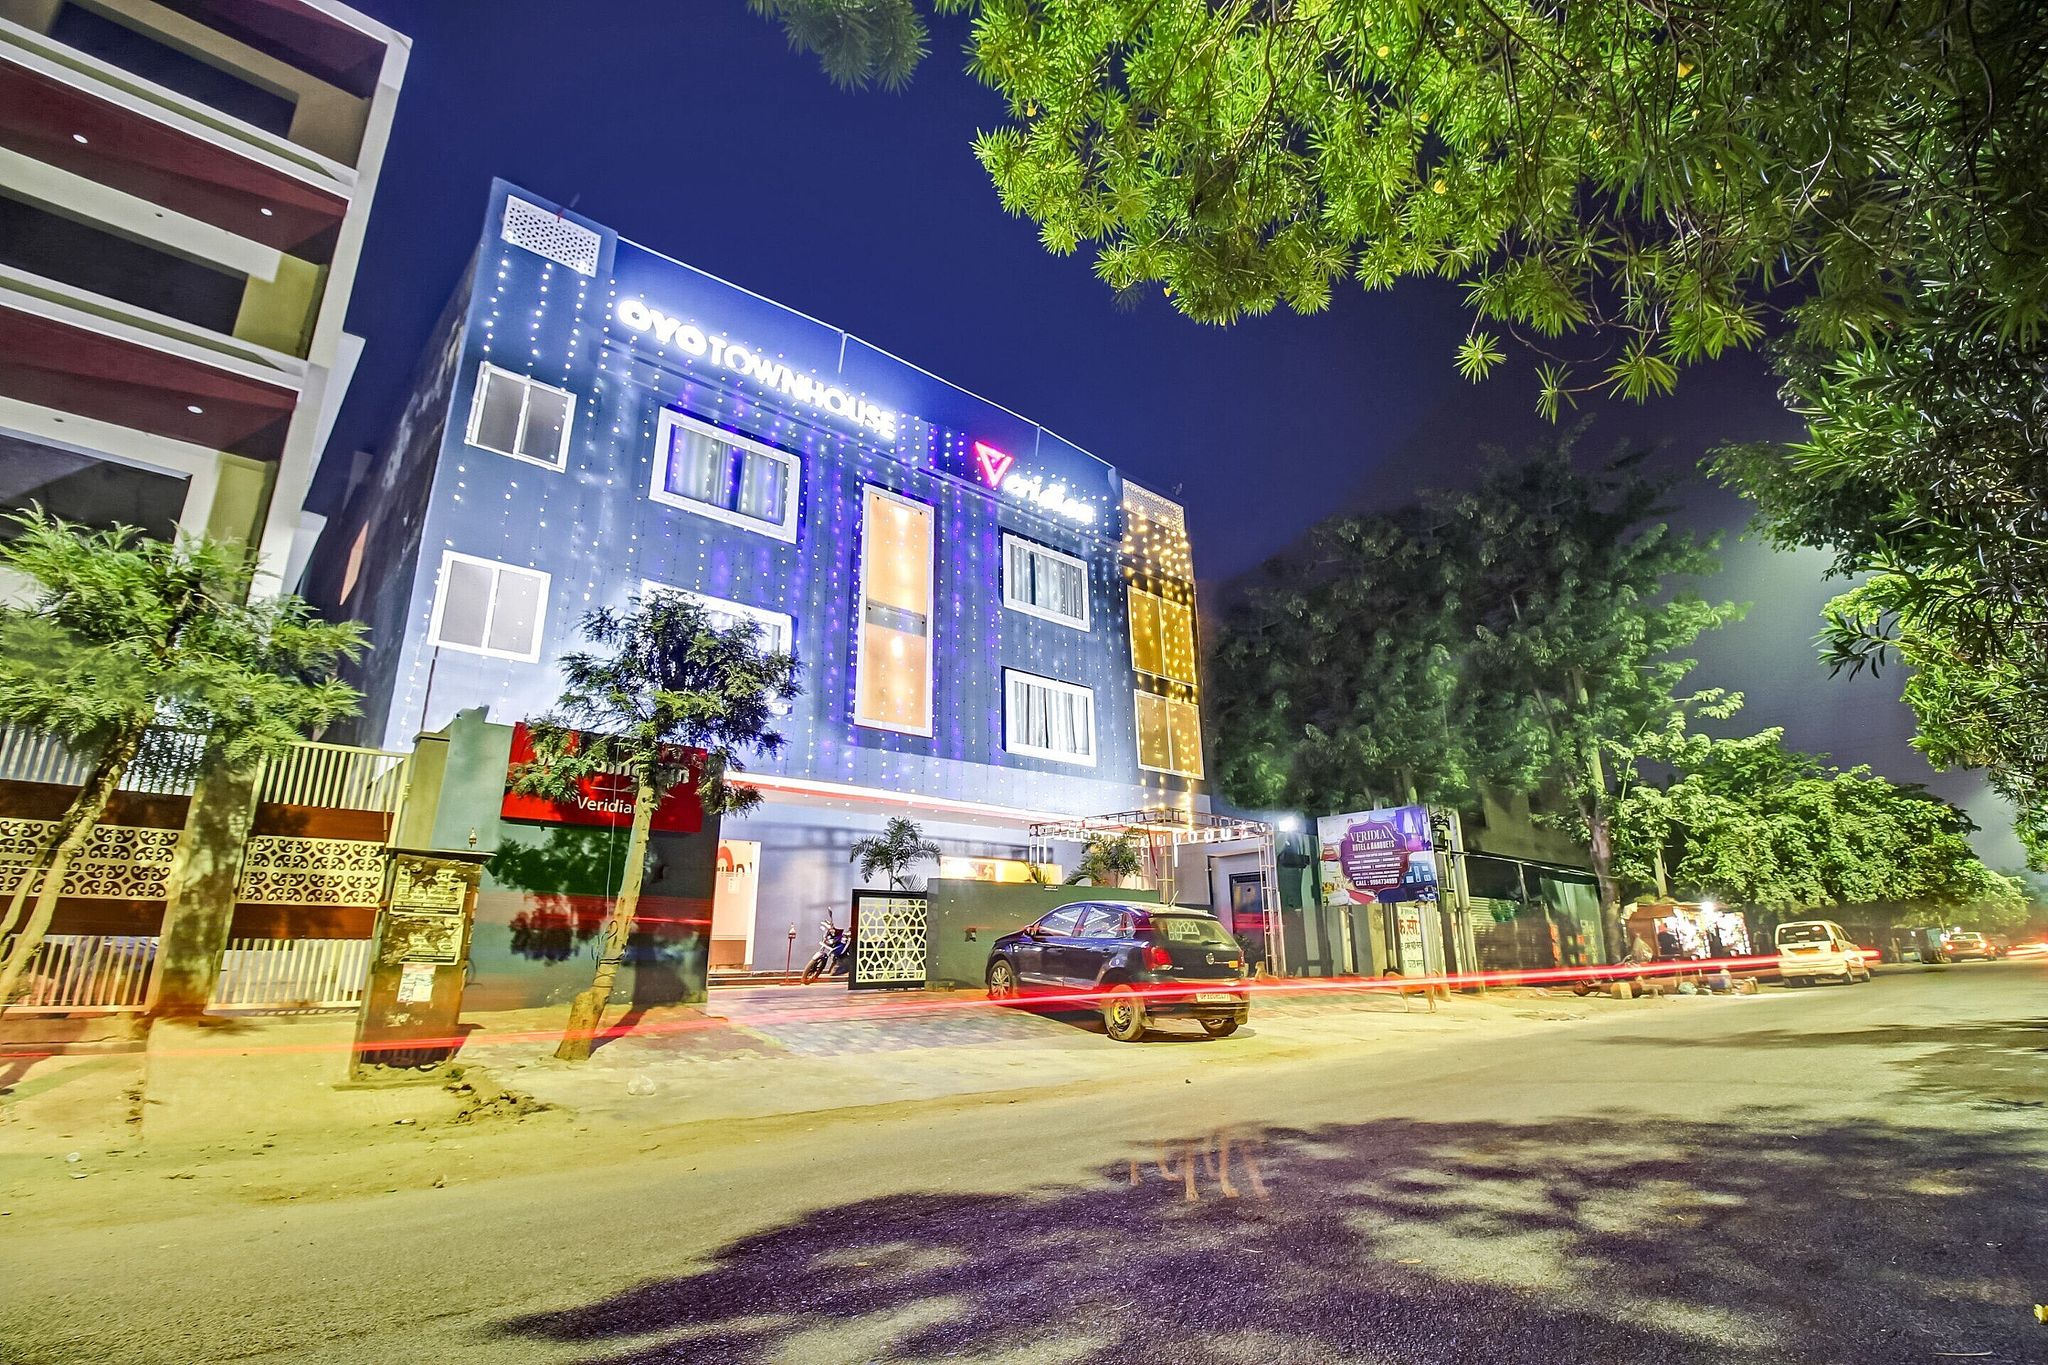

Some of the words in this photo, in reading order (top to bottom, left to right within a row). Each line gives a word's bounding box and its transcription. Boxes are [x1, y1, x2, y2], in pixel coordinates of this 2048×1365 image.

[617, 299, 708, 357] OYO
[708, 335, 898, 441] TOWNHOUSE
[577, 795, 637, 814] Veridia
[1350, 825, 1397, 843] VERIDIAN
[1352, 842, 1367, 852] HOTEL
[1355, 879, 1367, 887] CALL
